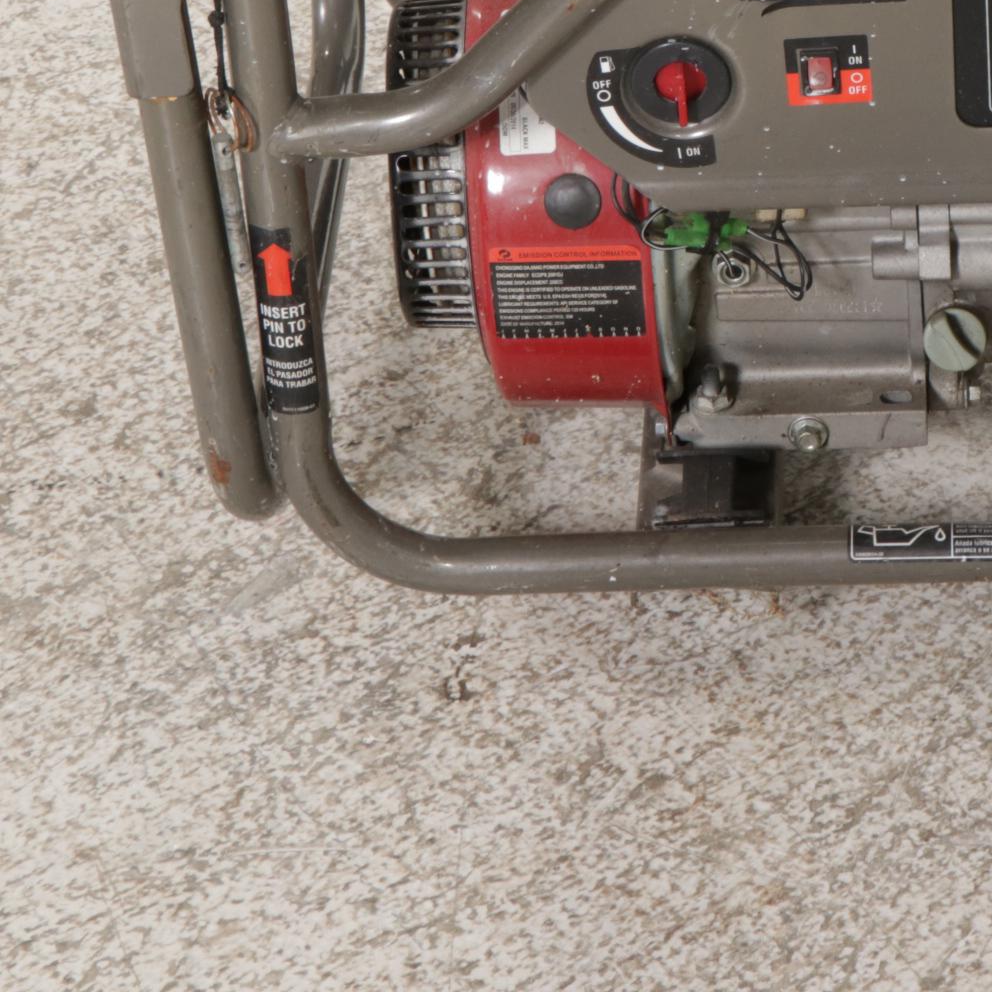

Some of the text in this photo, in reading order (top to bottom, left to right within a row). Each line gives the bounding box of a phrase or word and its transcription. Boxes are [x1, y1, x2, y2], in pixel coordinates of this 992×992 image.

[848, 55, 863, 65] ON
[592, 79, 612, 90] OFF
[848, 85, 868, 95] OFF
[685, 147, 701, 157] ON
[260, 303, 306, 319] INSERT
[263, 318, 306, 334] PIN TO
[268, 335, 304, 348] LOCK
[265, 357, 313, 370] INTRODUZCA
[275, 367, 314, 379] PASADOR
[285, 375, 317, 389] TRABAR
